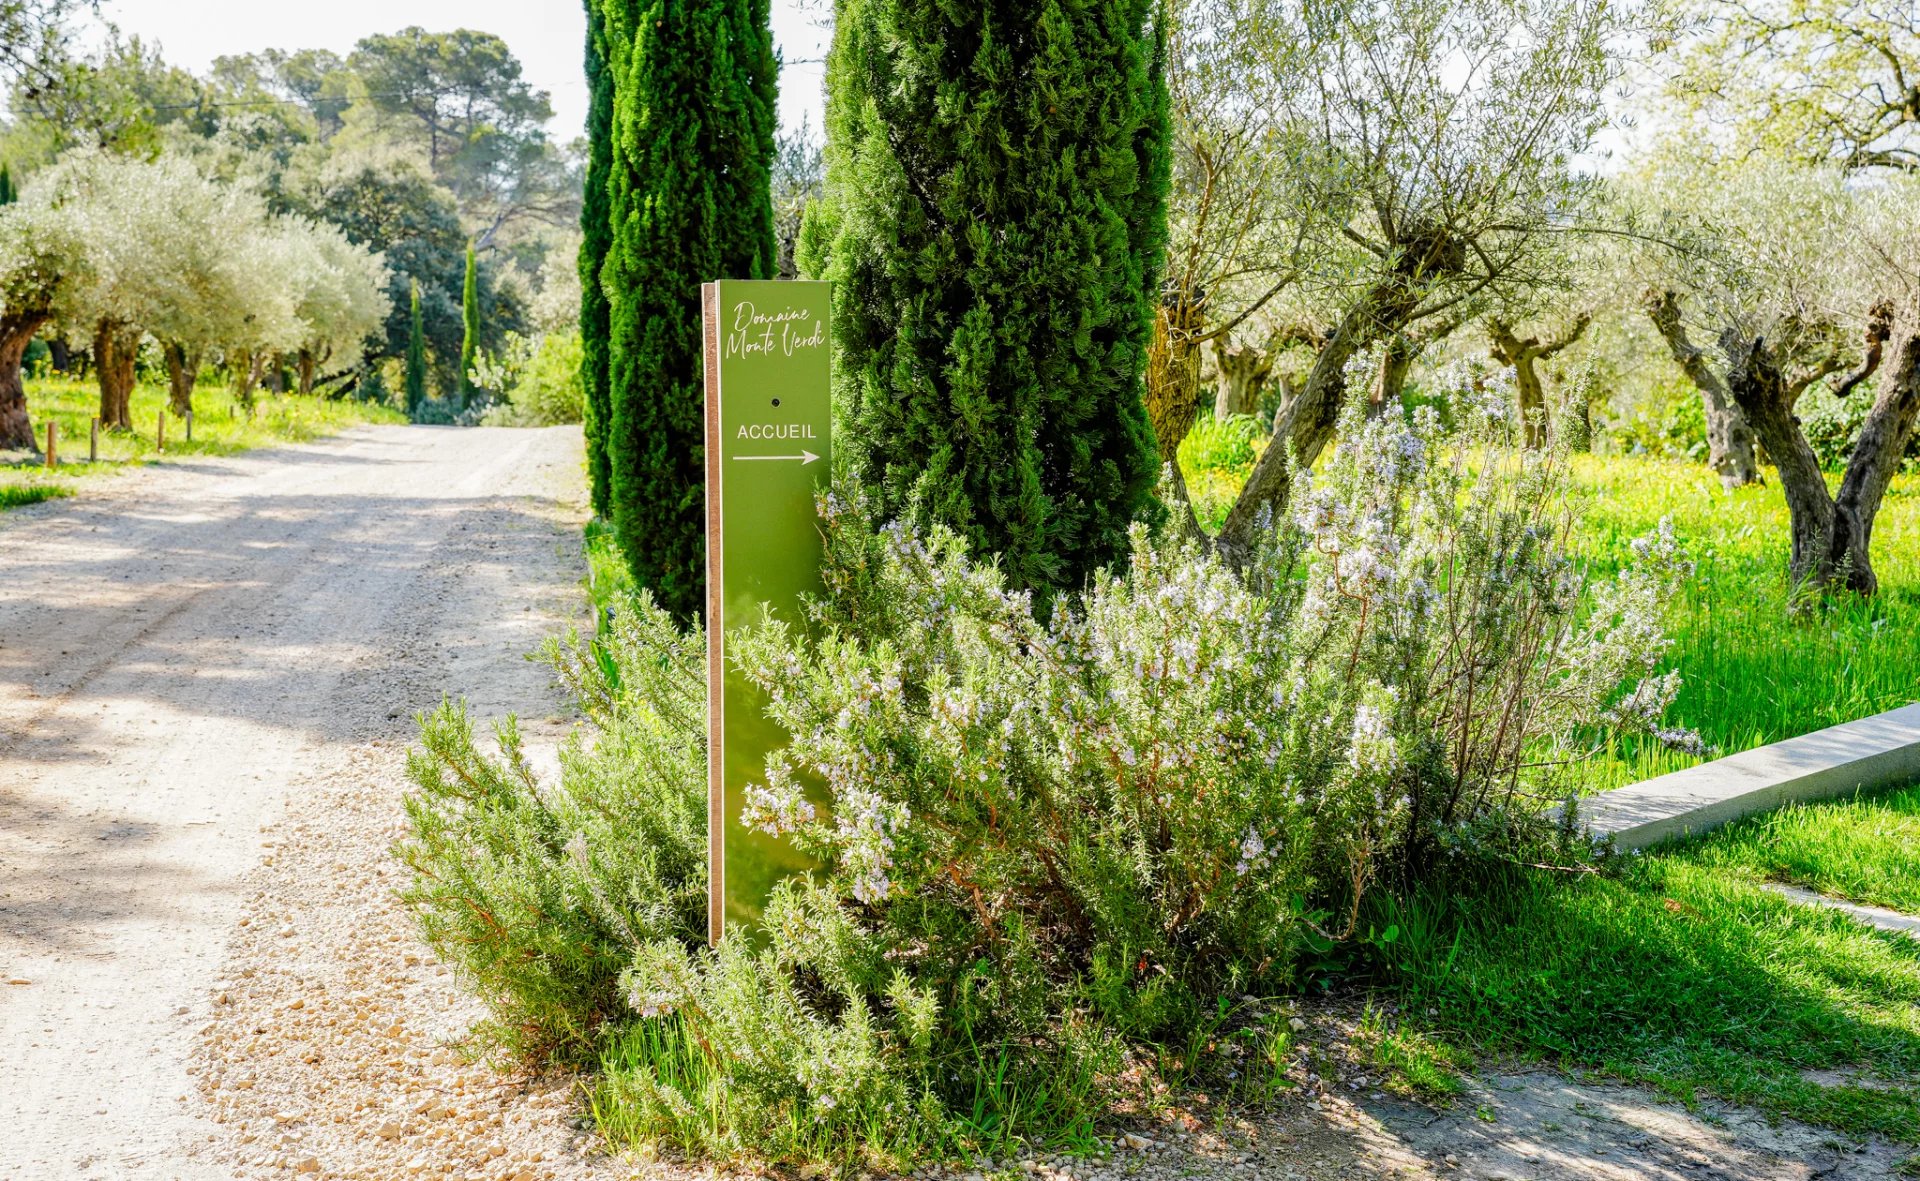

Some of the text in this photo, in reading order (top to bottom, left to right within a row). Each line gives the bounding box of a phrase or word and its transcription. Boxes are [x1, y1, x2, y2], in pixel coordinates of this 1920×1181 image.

[734, 301, 810, 331] Domaine
[726, 320, 825, 359] Monte Verdi
[737, 424, 816, 439] ACCUEIL
